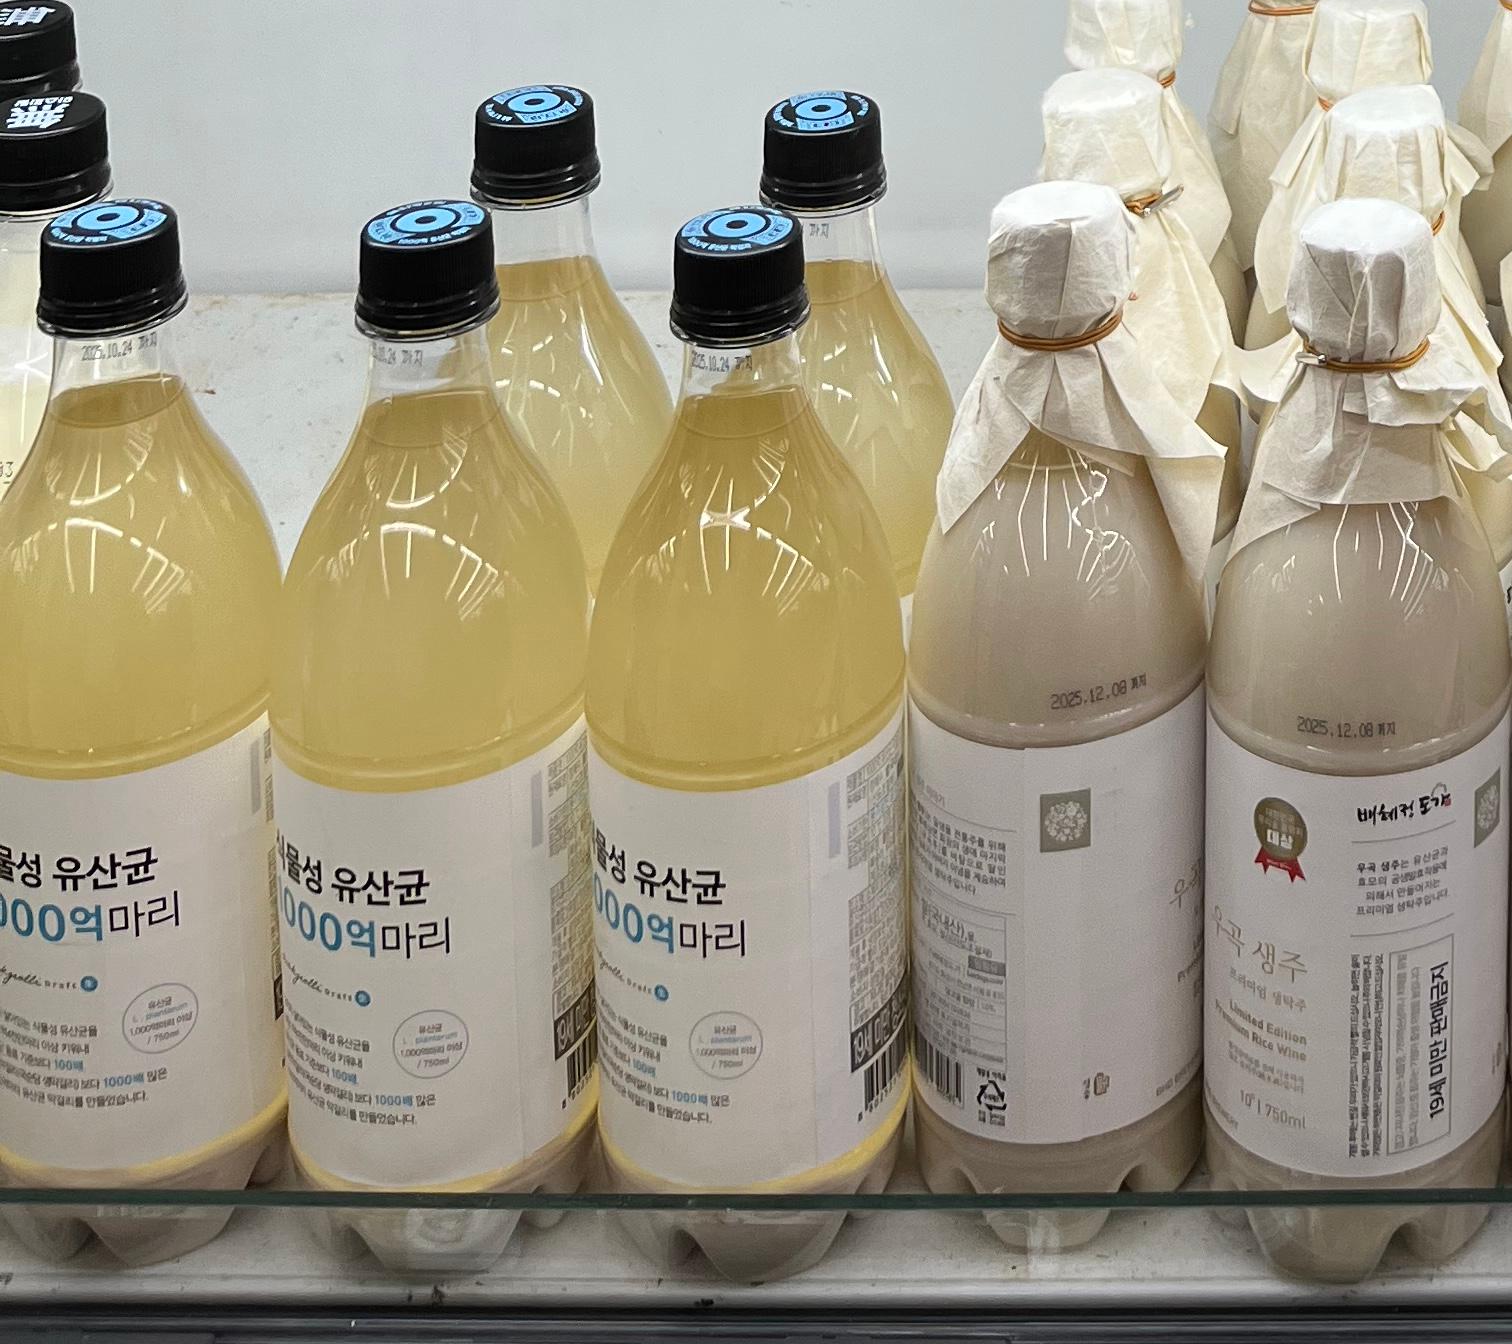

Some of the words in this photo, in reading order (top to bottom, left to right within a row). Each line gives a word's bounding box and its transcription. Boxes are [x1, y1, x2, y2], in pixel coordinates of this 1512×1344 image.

[1297, 715, 1374, 740] 2025.12.08
[52, 845, 159, 893] 유산균
[331, 867, 430, 906] 유산균
[634, 860, 726, 905] 유산균
[1252, 939, 1308, 986] 생주
[1265, 1102, 1306, 1131] 750ml
